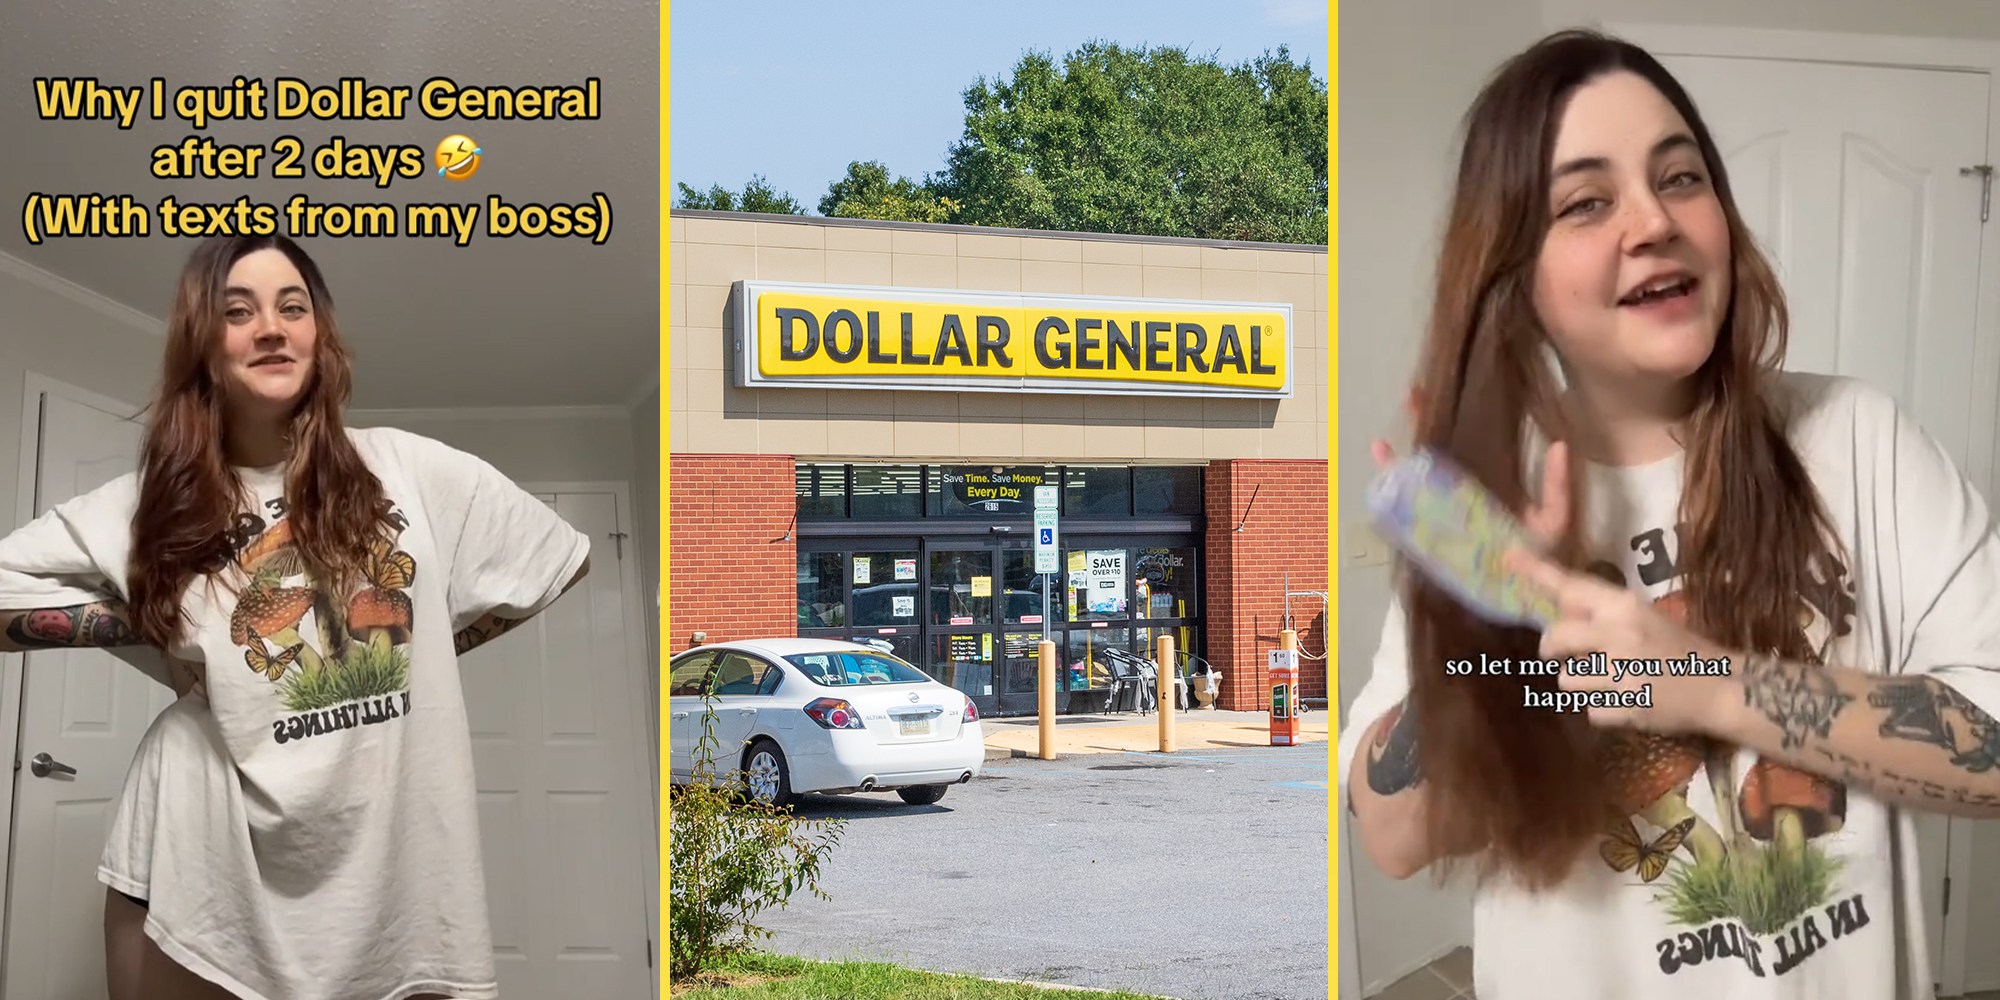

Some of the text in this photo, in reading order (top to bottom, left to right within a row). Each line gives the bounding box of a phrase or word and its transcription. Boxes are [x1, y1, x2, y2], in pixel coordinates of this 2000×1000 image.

[775, 306, 1277, 375] DOLLAR GENERAL
[943, 473, 1043, 484] Save Time. Save Money.
[967, 486, 1021, 499] Every Day.
[1093, 558, 1121, 569] SAVE
